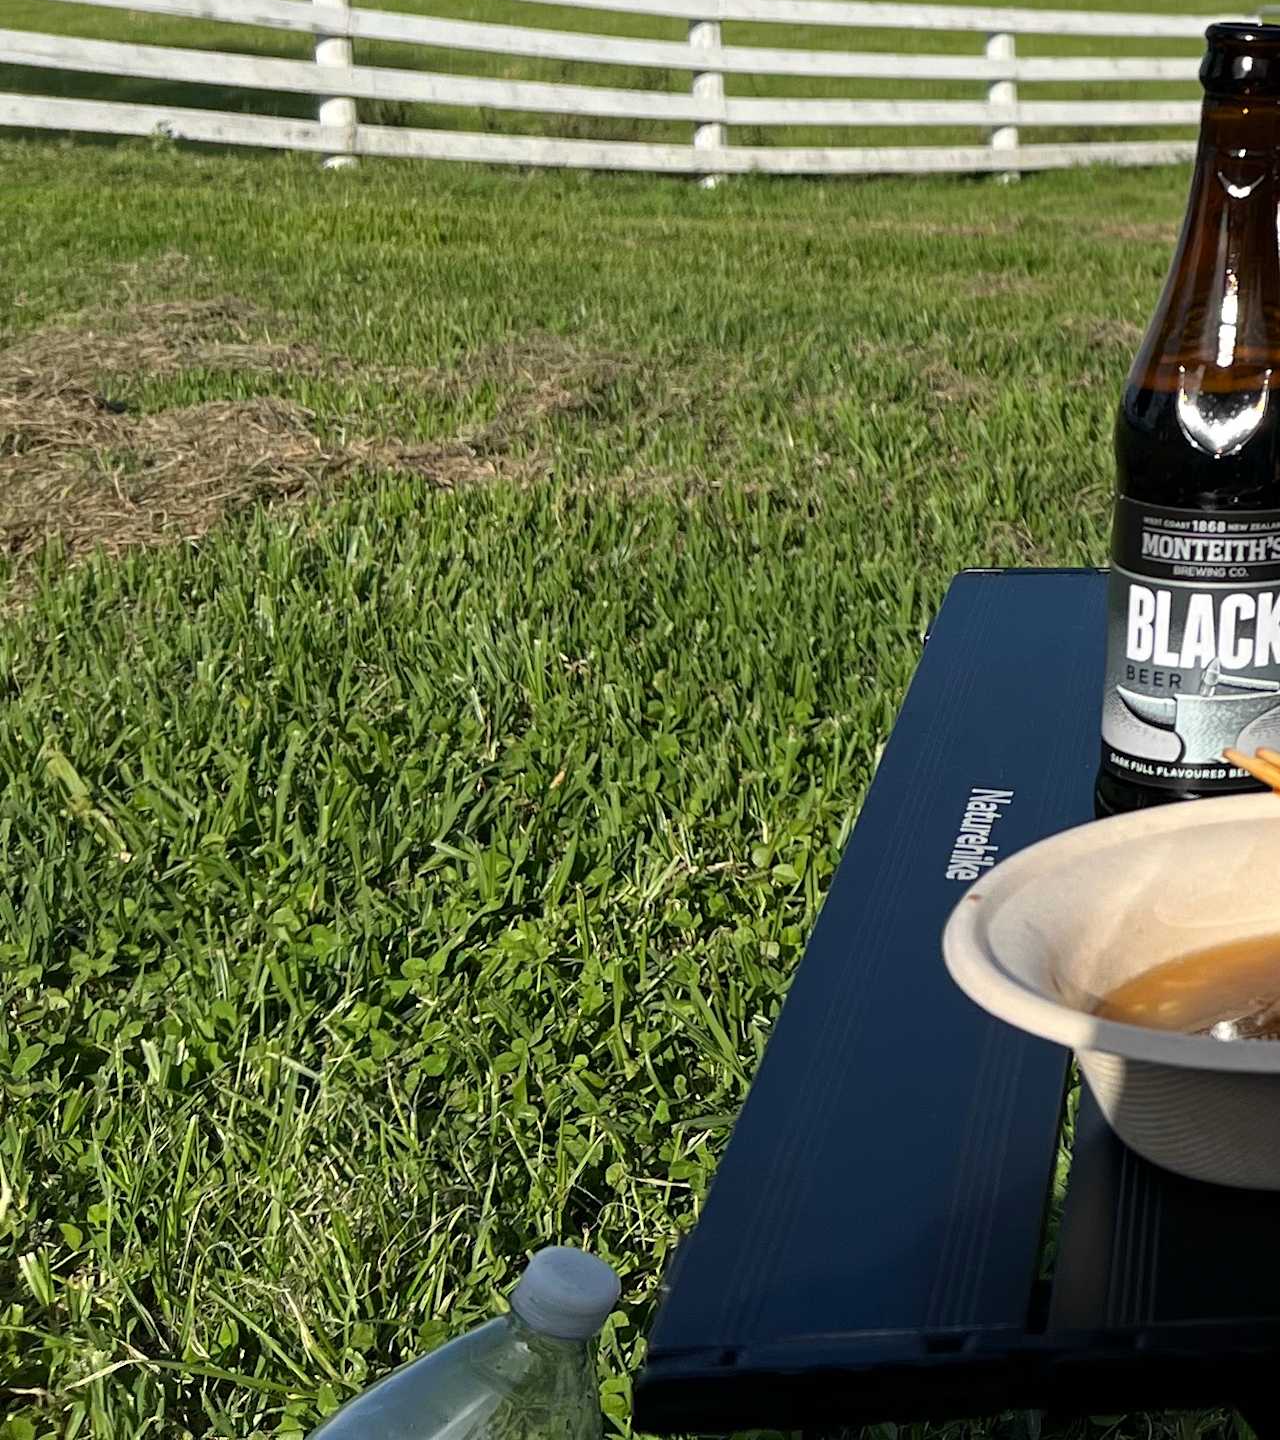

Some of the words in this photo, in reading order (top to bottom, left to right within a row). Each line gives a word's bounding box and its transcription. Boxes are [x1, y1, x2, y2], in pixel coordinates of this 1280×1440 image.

[1227, 523, 1249, 532] NEW
[1173, 565, 1227, 578] BREWING
[1228, 567, 1250, 578] CO.
[1126, 664, 1183, 689] BEER
[1130, 760, 1155, 776] FULL
[1156, 766, 1227, 780] FLAVOURED
[945, 788, 1014, 880] Naturehike
